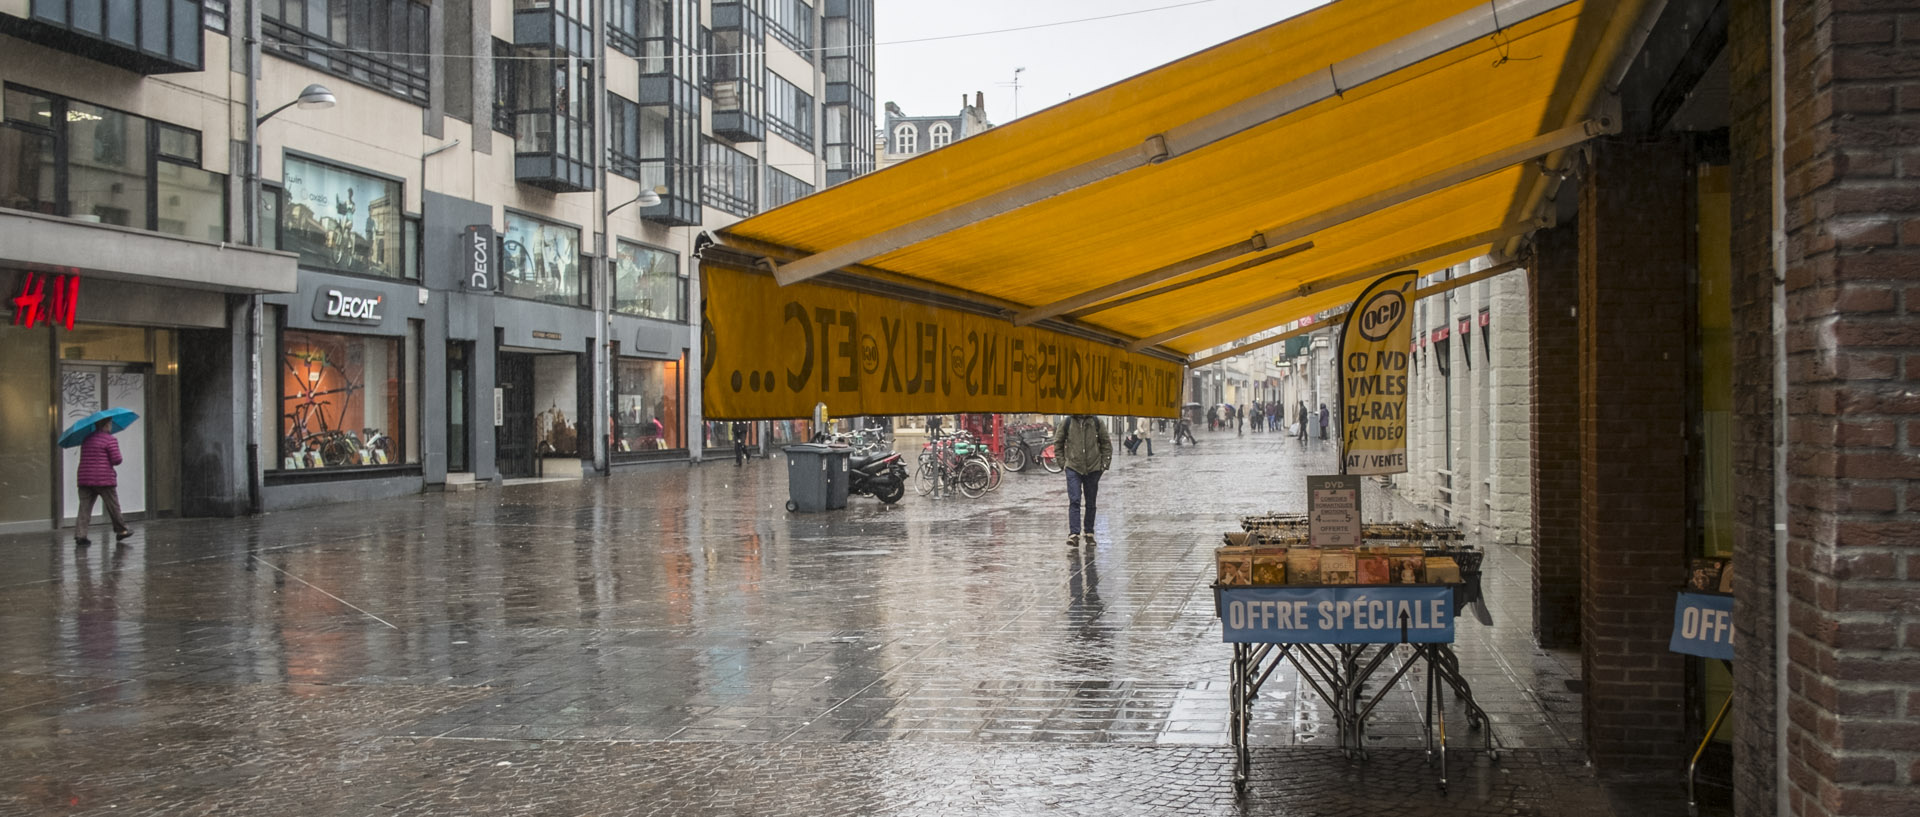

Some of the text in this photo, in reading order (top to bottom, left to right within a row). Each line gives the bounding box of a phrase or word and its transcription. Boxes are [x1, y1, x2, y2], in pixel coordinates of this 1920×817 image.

[13, 272, 80, 331] H&M
[1364, 301, 1400, 330] OCD
[1347, 352, 1369, 373] CD
[1362, 422, 1404, 440] VIDÉO
[1371, 453, 1403, 468] VENTE
[1325, 481, 1344, 489] DVD
[1229, 595, 1446, 630] OFFRE SPÉCIALE
